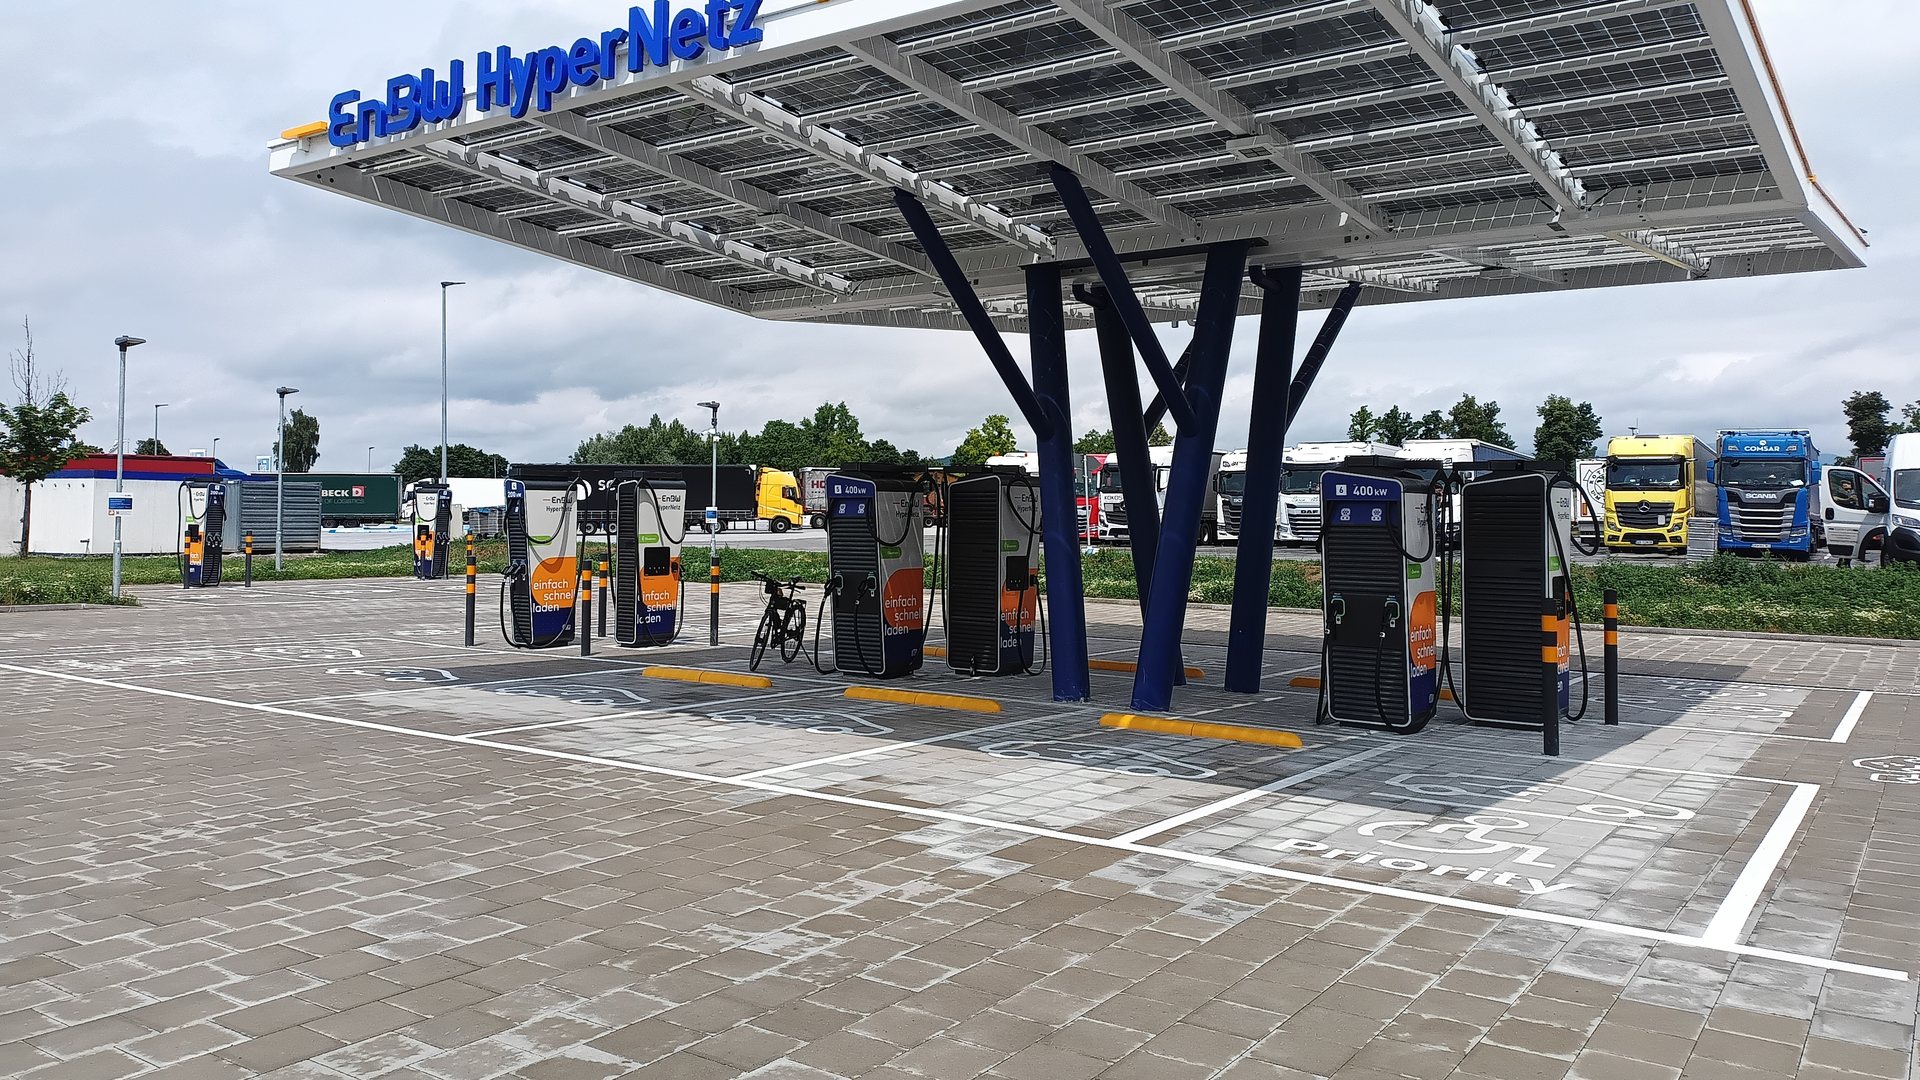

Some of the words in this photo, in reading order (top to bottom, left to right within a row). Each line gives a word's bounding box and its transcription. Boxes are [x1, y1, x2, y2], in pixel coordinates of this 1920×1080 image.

[328, 59, 464, 148] EnBW
[476, 0, 764, 119] HyperNetz
[844, 486, 858, 494] 400
[1353, 486, 1373, 496] 400
[533, 579, 568, 590] einfach
[544, 589, 576, 600] schnell
[885, 594, 917, 608] einfach
[533, 602, 559, 613] laden
[647, 601, 676, 612] schnell
[894, 608, 922, 621] schnell
[885, 622, 908, 636] laden
[1411, 625, 1432, 642] einfach
[1417, 640, 1436, 658] schnell
[1411, 660, 1427, 678] laden
[1271, 838, 1578, 895] Priority
